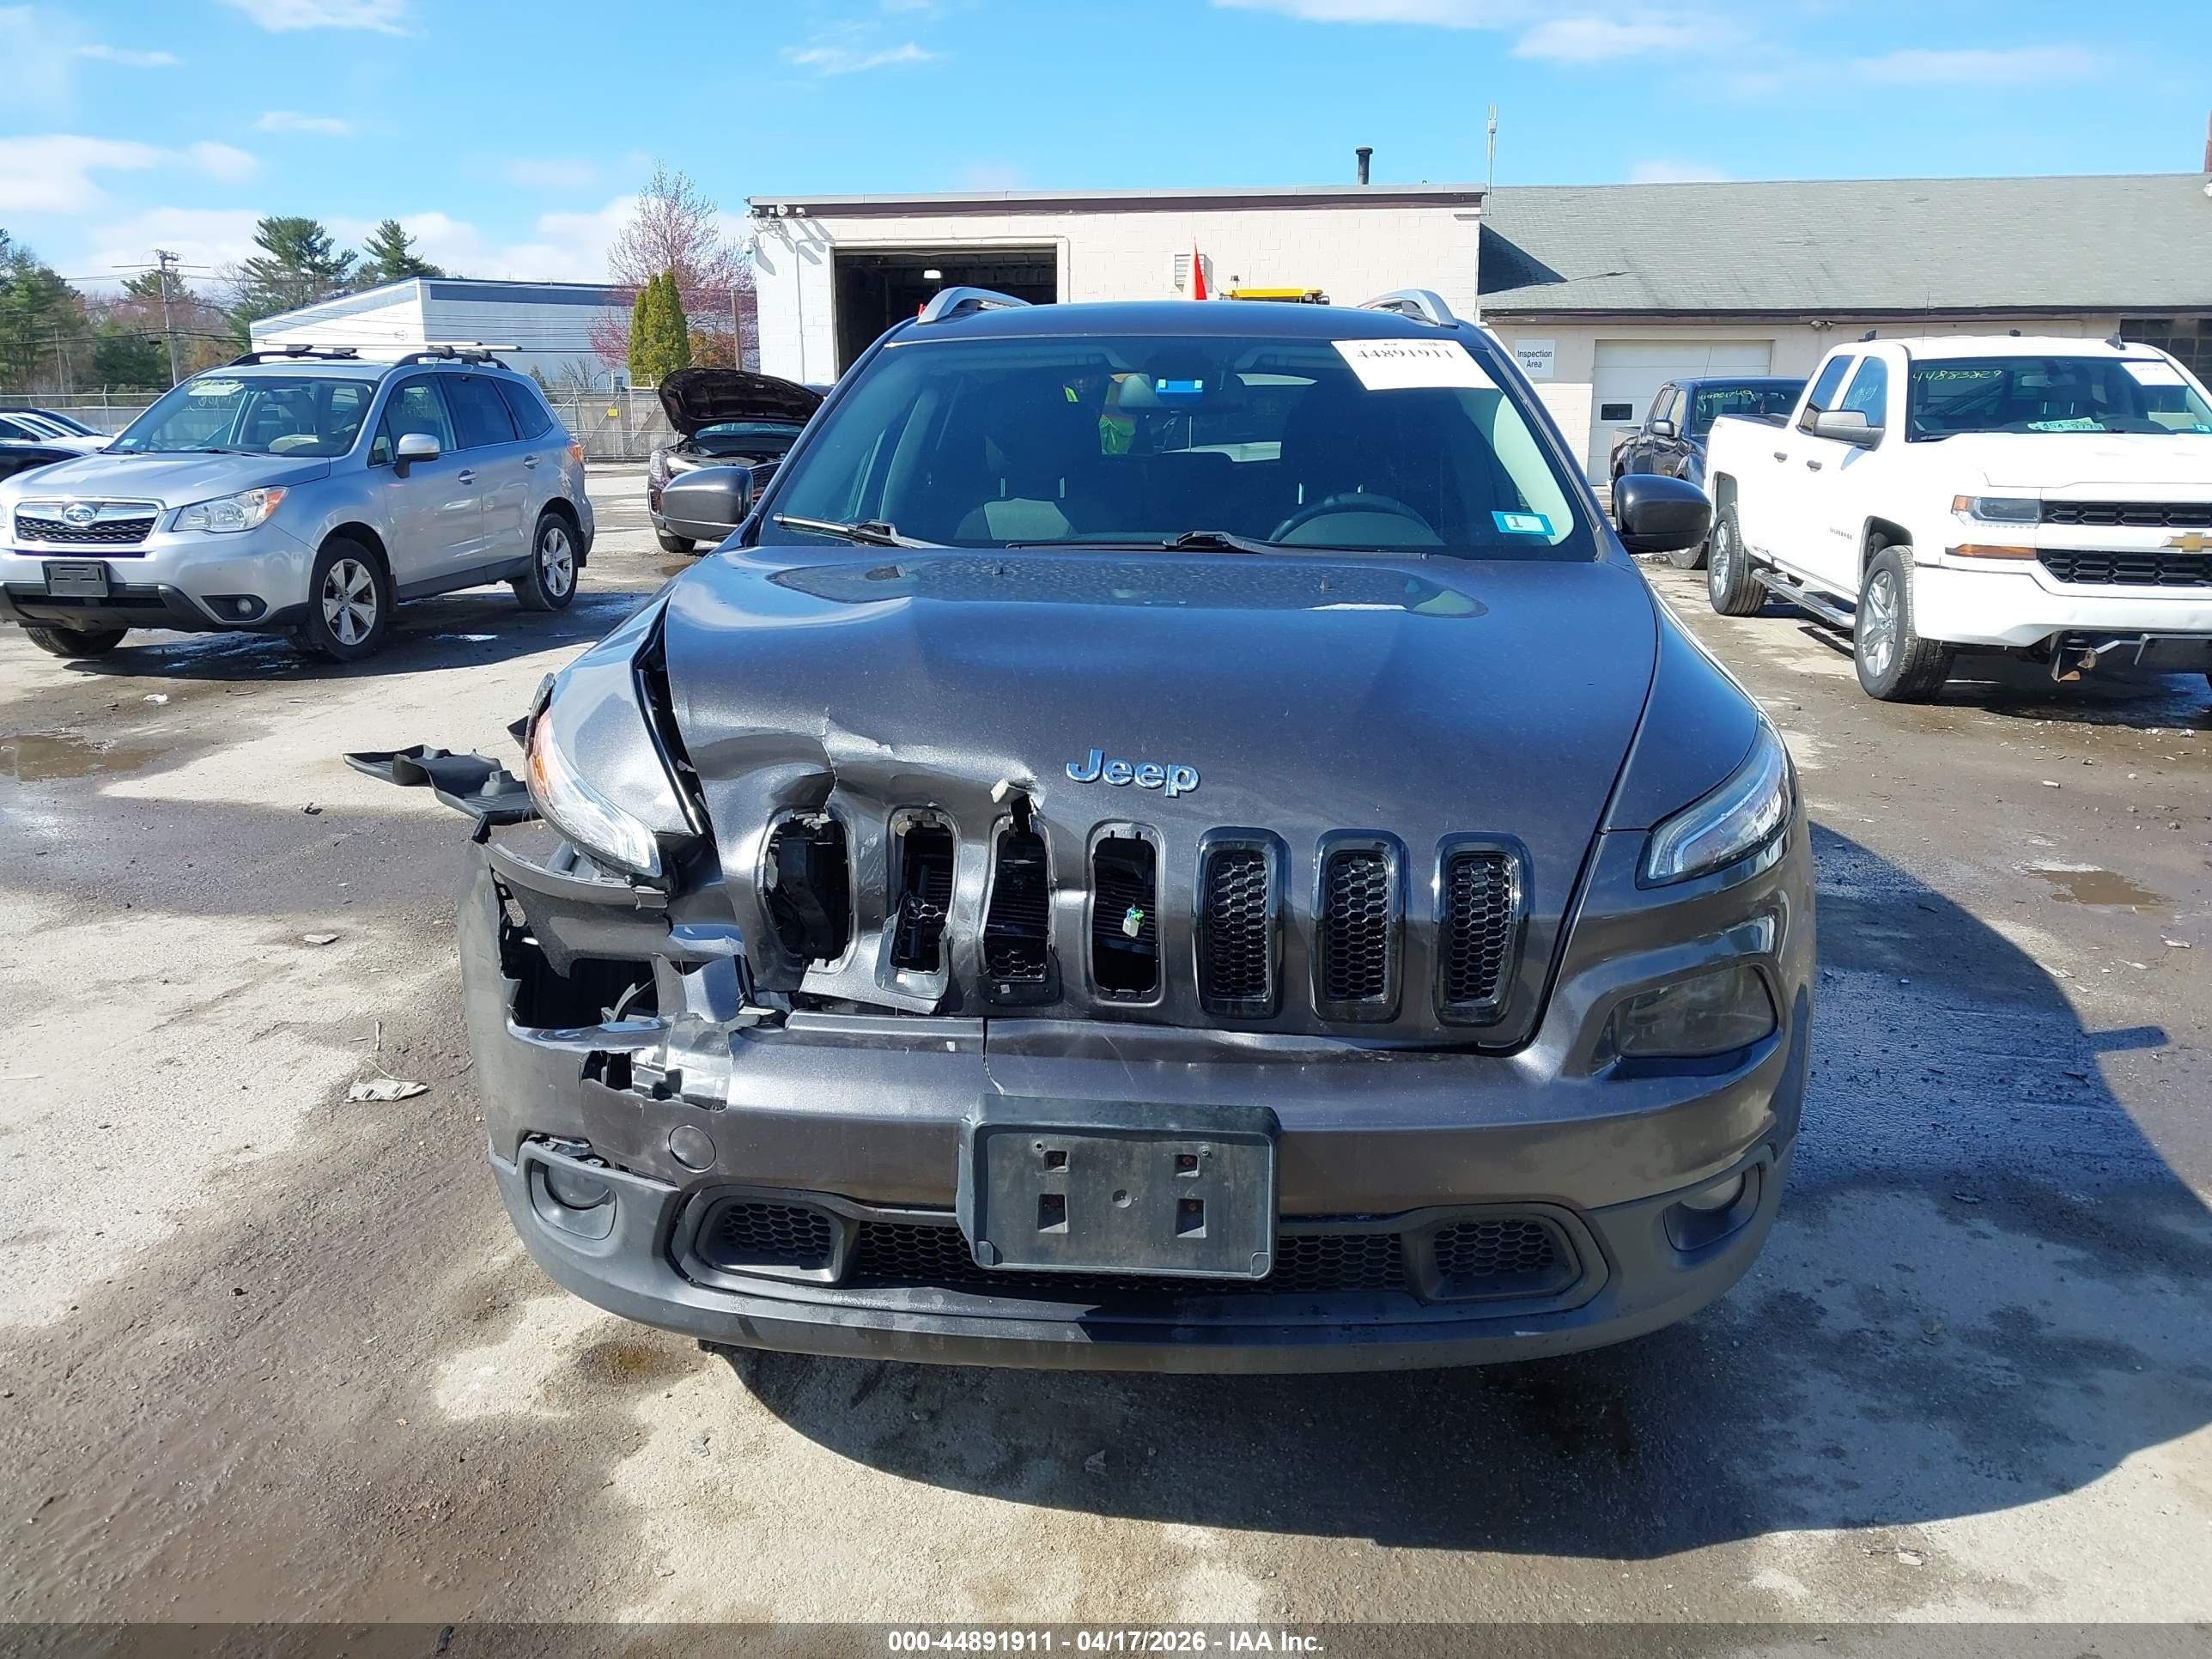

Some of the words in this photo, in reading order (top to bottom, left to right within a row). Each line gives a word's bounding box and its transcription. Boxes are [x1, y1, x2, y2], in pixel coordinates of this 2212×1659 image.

[1356, 349, 1455, 359] 44891911
[1517, 349, 1553, 359] Inspection
[1526, 359, 1542, 368] Area
[1066, 748, 1200, 798] Jeep
